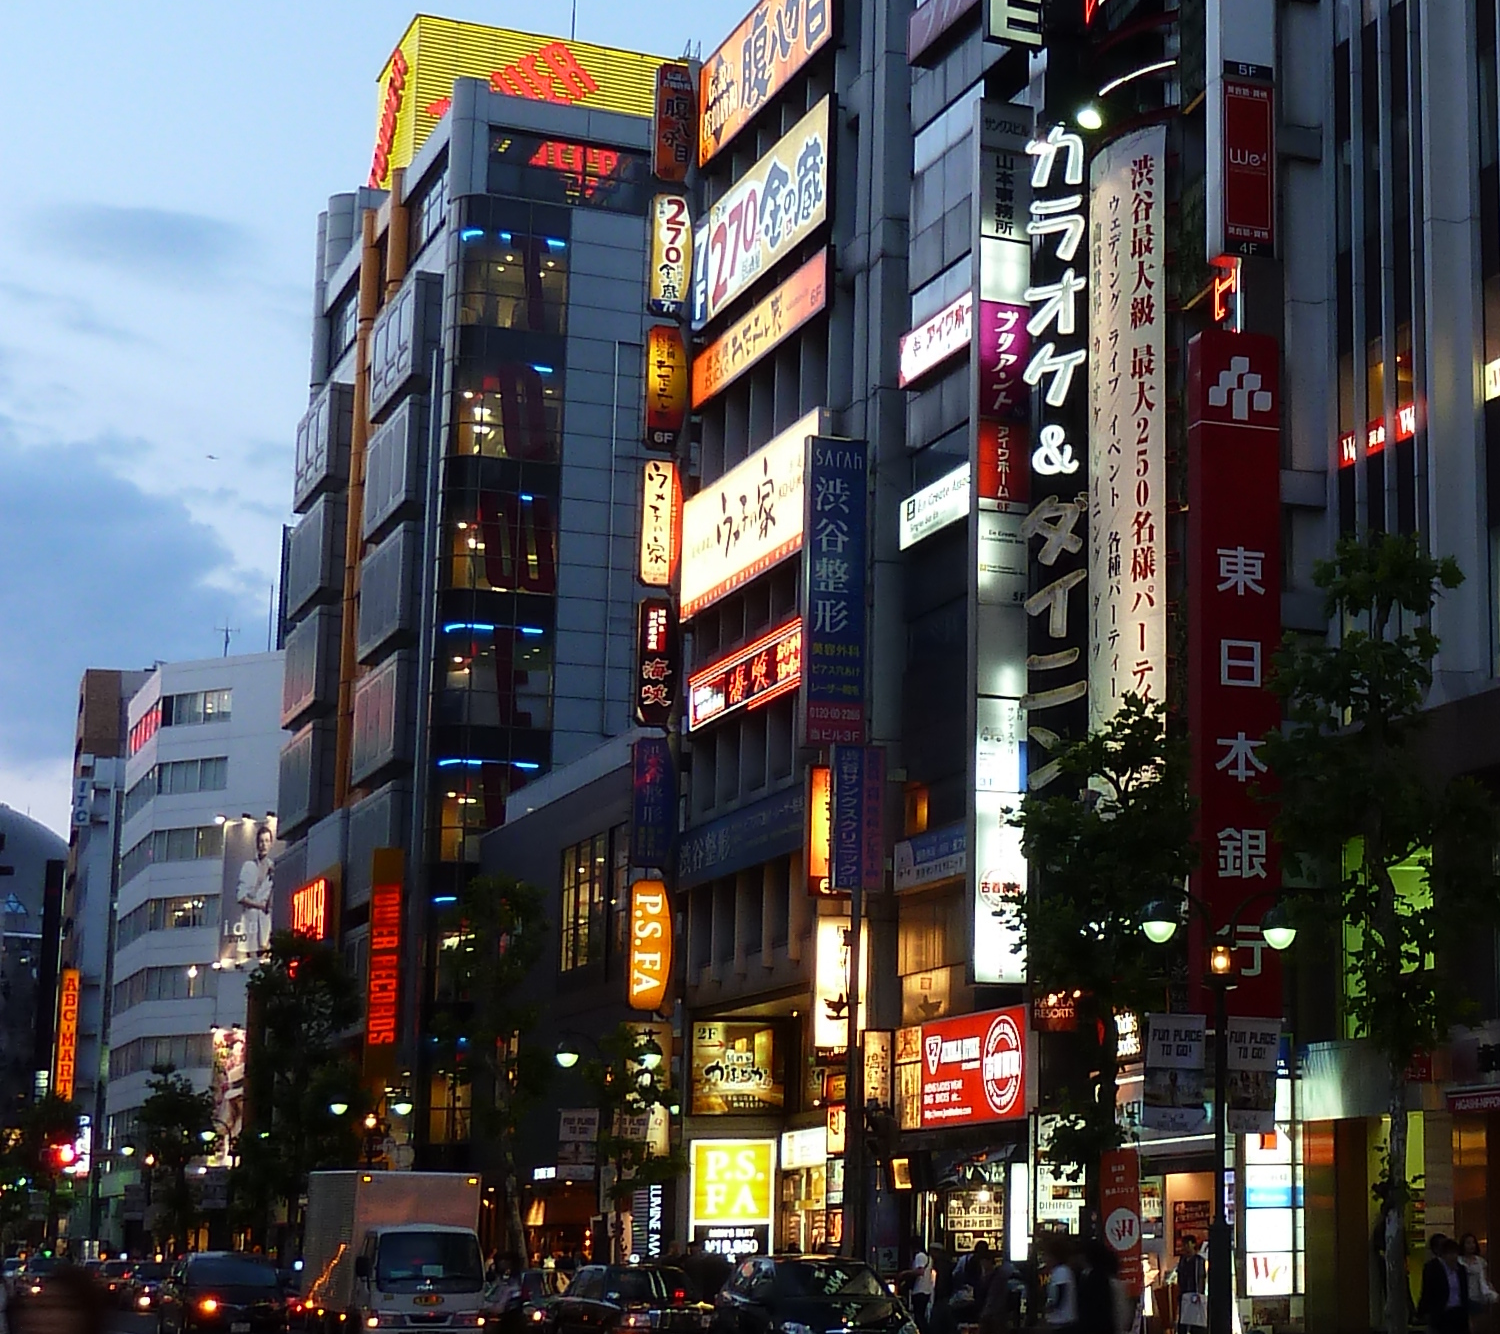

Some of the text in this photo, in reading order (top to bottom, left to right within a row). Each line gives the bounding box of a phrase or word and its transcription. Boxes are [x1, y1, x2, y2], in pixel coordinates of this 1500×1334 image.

[1239, 65, 1257, 76] 5F
[662, 96, 690, 163] 腹八分目
[759, 137, 823, 249] 金の蔵
[995, 155, 1014, 235] 山本事務所
[664, 199, 686, 265] 270
[1129, 153, 1155, 329] 渋谷最大級
[1239, 243, 1257, 254] 4F
[694, 223, 709, 320] 7F
[661, 300, 676, 312] 7F
[809, 283, 822, 308] 6F
[653, 430, 673, 443] 6F
[997, 425, 1008, 498] アイワホーム
[814, 476, 850, 633] 渋谷整形
[1012, 592, 1024, 602] 5F
[812, 643, 859, 657] 美容外科
[642, 659, 671, 706] 海峡
[810, 727, 860, 742] 当ビル3F
[1216, 545, 1267, 976] 東日本銀行
[679, 830, 730, 877] 渋谷整形
[1034, 1008, 1074, 1019] RESORTS
[60, 976, 78, 1099] ABC-MART
[697, 1027, 717, 1039] 2F
[1153, 1029, 1201, 1042] FUN PLACE
[1230, 1031, 1276, 1045] FUN PLACE
[1162, 1044, 1191, 1057] TO GO!
[1239, 1047, 1265, 1059] TO GO!
[705, 1150, 763, 1181] P.S.
[647, 1185, 662, 1234] LUMINE
[704, 1183, 758, 1213] FA
[1039, 1201, 1072, 1209] DINING
